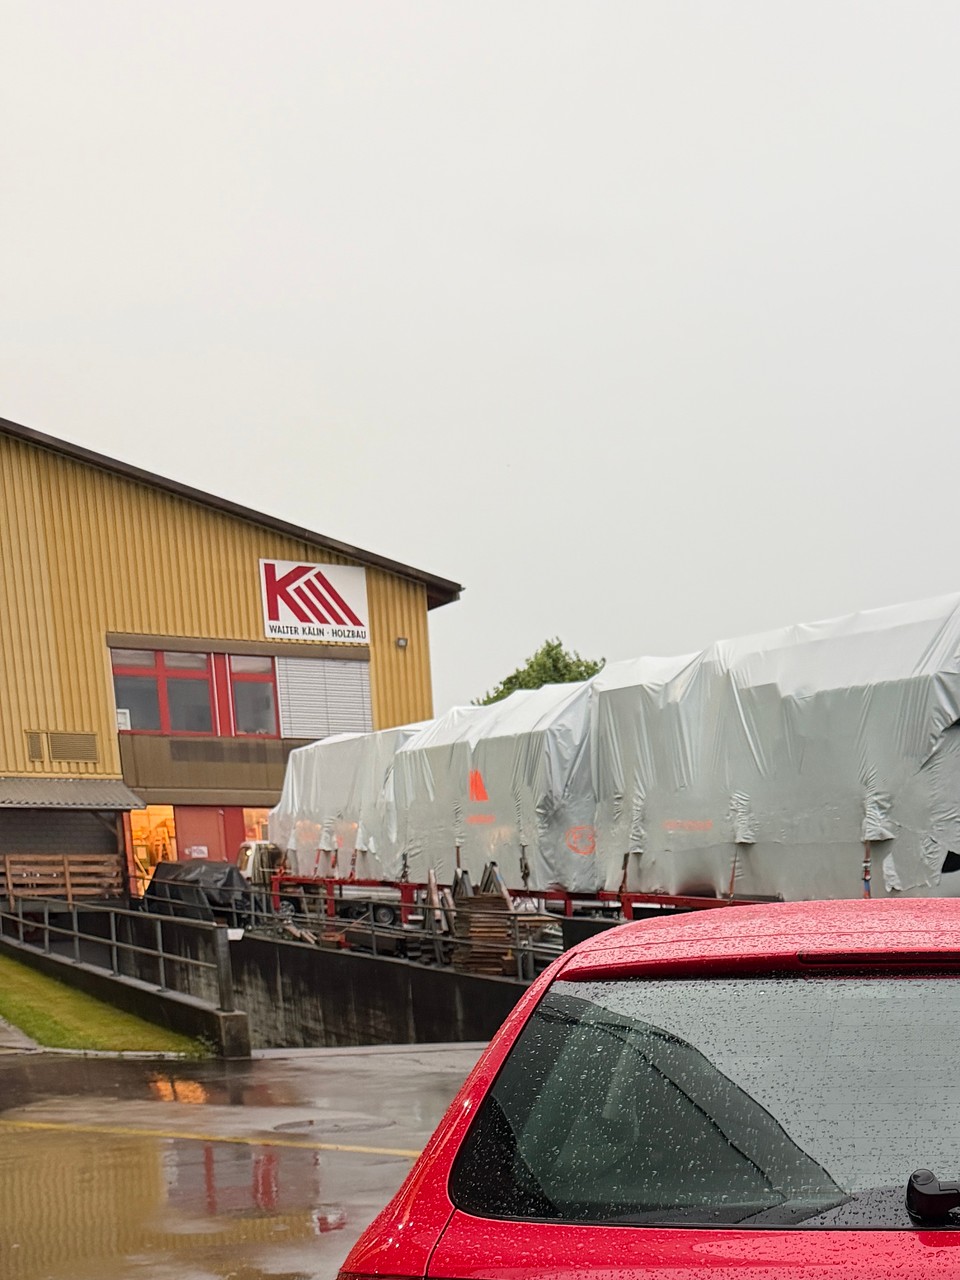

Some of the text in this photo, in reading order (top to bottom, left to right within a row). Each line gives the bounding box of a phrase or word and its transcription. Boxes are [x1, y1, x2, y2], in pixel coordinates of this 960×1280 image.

[269, 625, 366, 639] WALTER KÄLIN HOLZBAU
